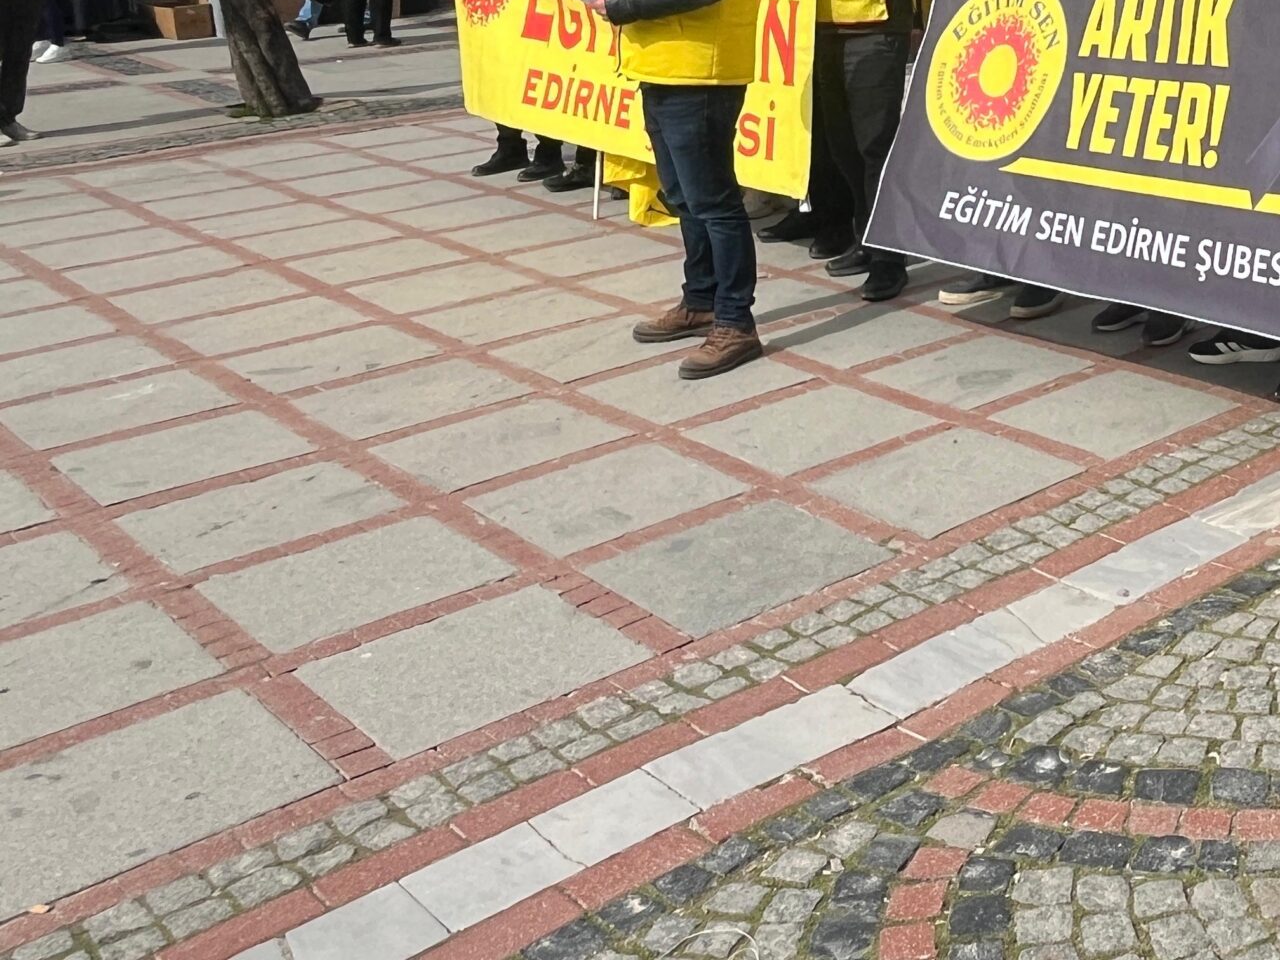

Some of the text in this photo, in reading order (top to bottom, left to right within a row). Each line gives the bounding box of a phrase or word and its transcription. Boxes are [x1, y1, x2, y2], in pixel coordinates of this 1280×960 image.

[1029, 1, 1060, 51] SEN
[522, 64, 637, 129] EDİRNE
[1065, 72, 1231, 168] YETER!
[939, 186, 1032, 236] EĞİTİM
[1035, 211, 1085, 248] SEN
[1091, 217, 1190, 269] EDİRNE
